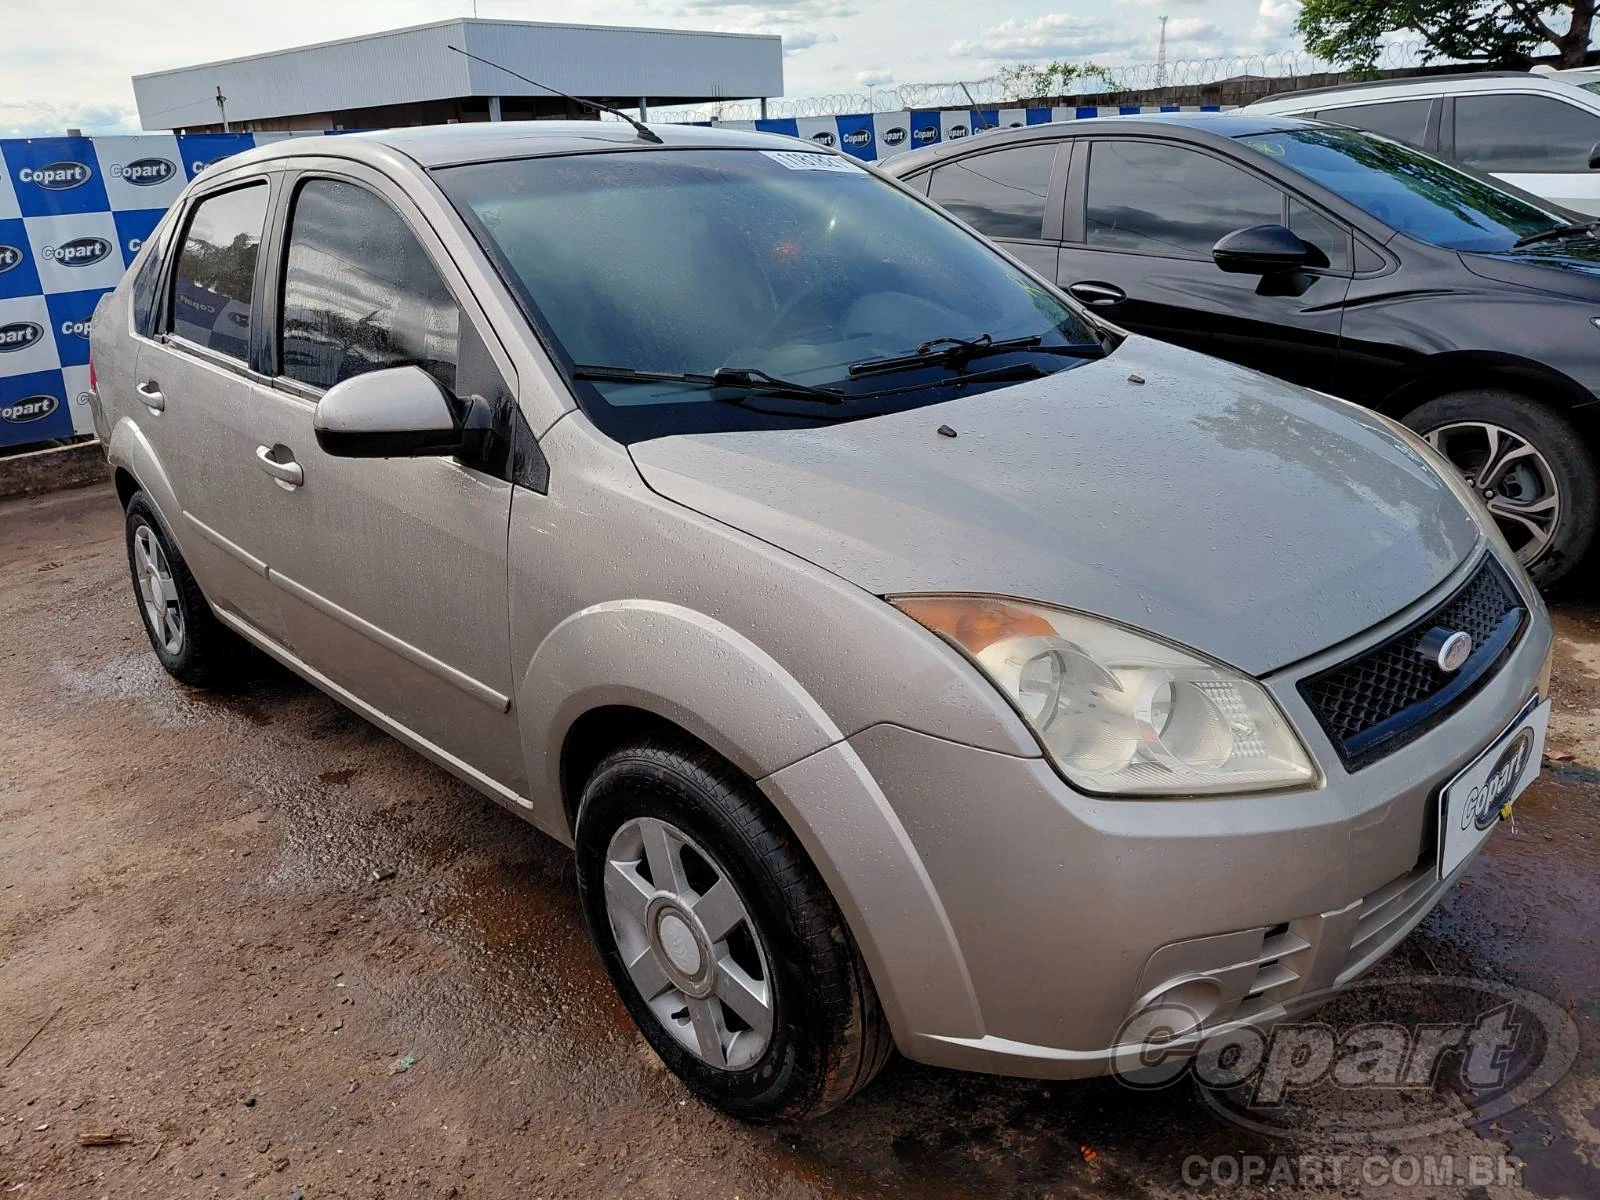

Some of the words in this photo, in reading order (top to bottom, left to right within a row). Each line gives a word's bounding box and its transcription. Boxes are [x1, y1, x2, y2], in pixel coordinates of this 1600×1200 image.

[843, 132, 869, 145] Copart
[880, 130, 904, 143] Copart
[913, 129, 936, 140] Copart
[19, 167, 82, 184] Copart
[110, 163, 168, 179] Copart
[41, 242, 101, 261] Copart
[0, 399, 50, 419] opart
[1461, 743, 1527, 831] Copart
